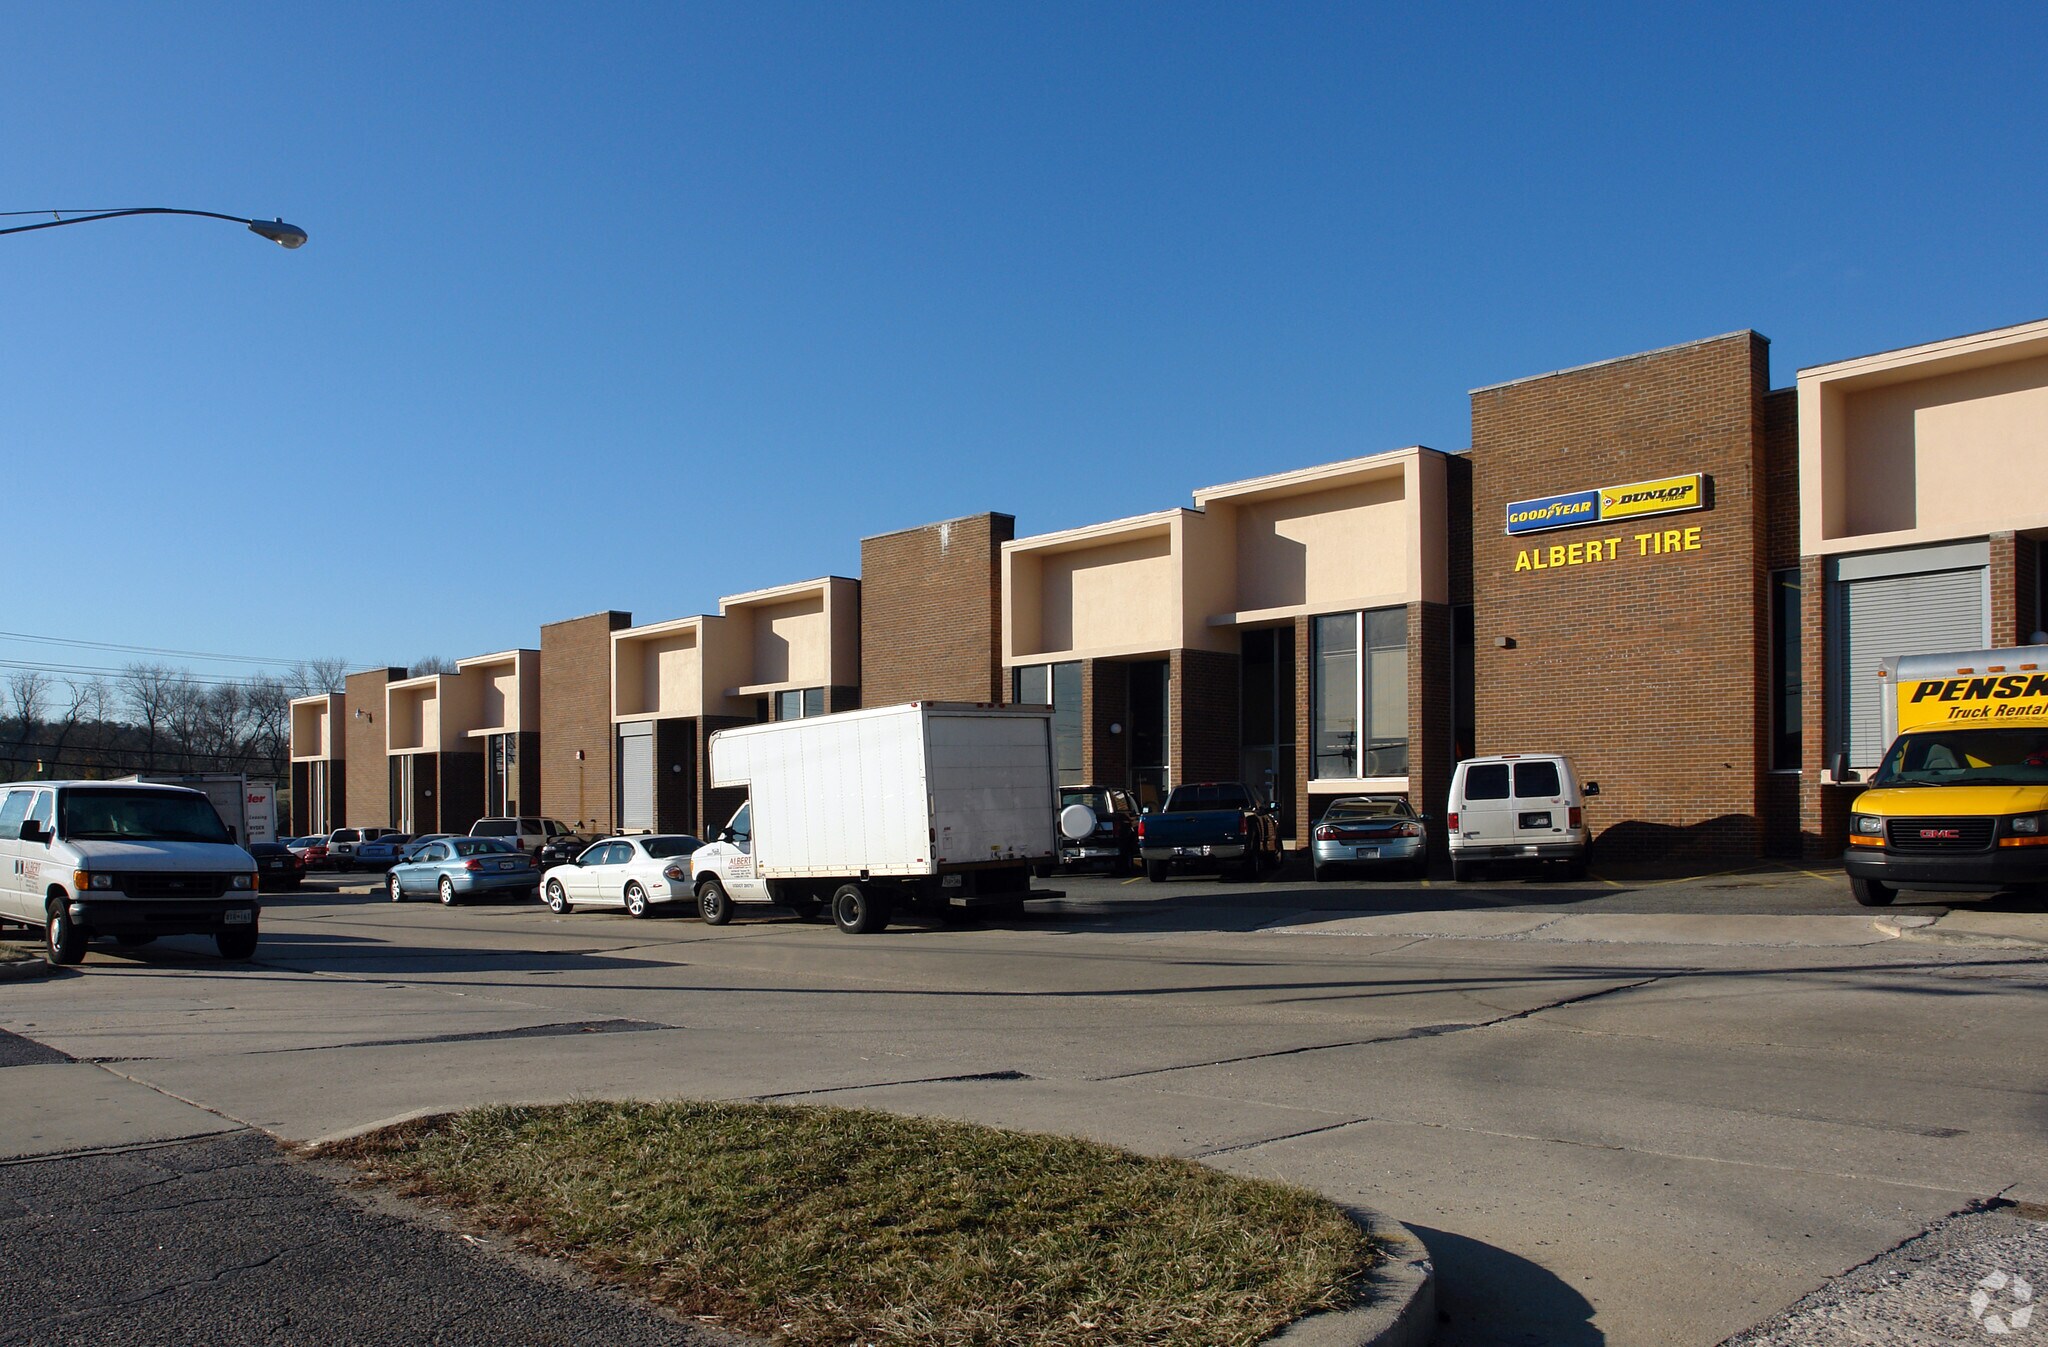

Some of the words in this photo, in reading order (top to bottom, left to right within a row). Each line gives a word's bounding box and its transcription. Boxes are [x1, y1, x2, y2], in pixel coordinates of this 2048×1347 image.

[1619, 485, 1693, 504] DUNLOP
[1661, 494, 1685, 502] TIRES
[1509, 501, 1592, 523] GOODYEAR
[1514, 537, 1622, 572] ALBERT
[1635, 526, 1702, 556] TIRE
[1948, 705, 1992, 719] Truck
[1994, 702, 2048, 717] Rental
[1920, 829, 1959, 838] GMC
[729, 856, 752, 865] ALBERT
